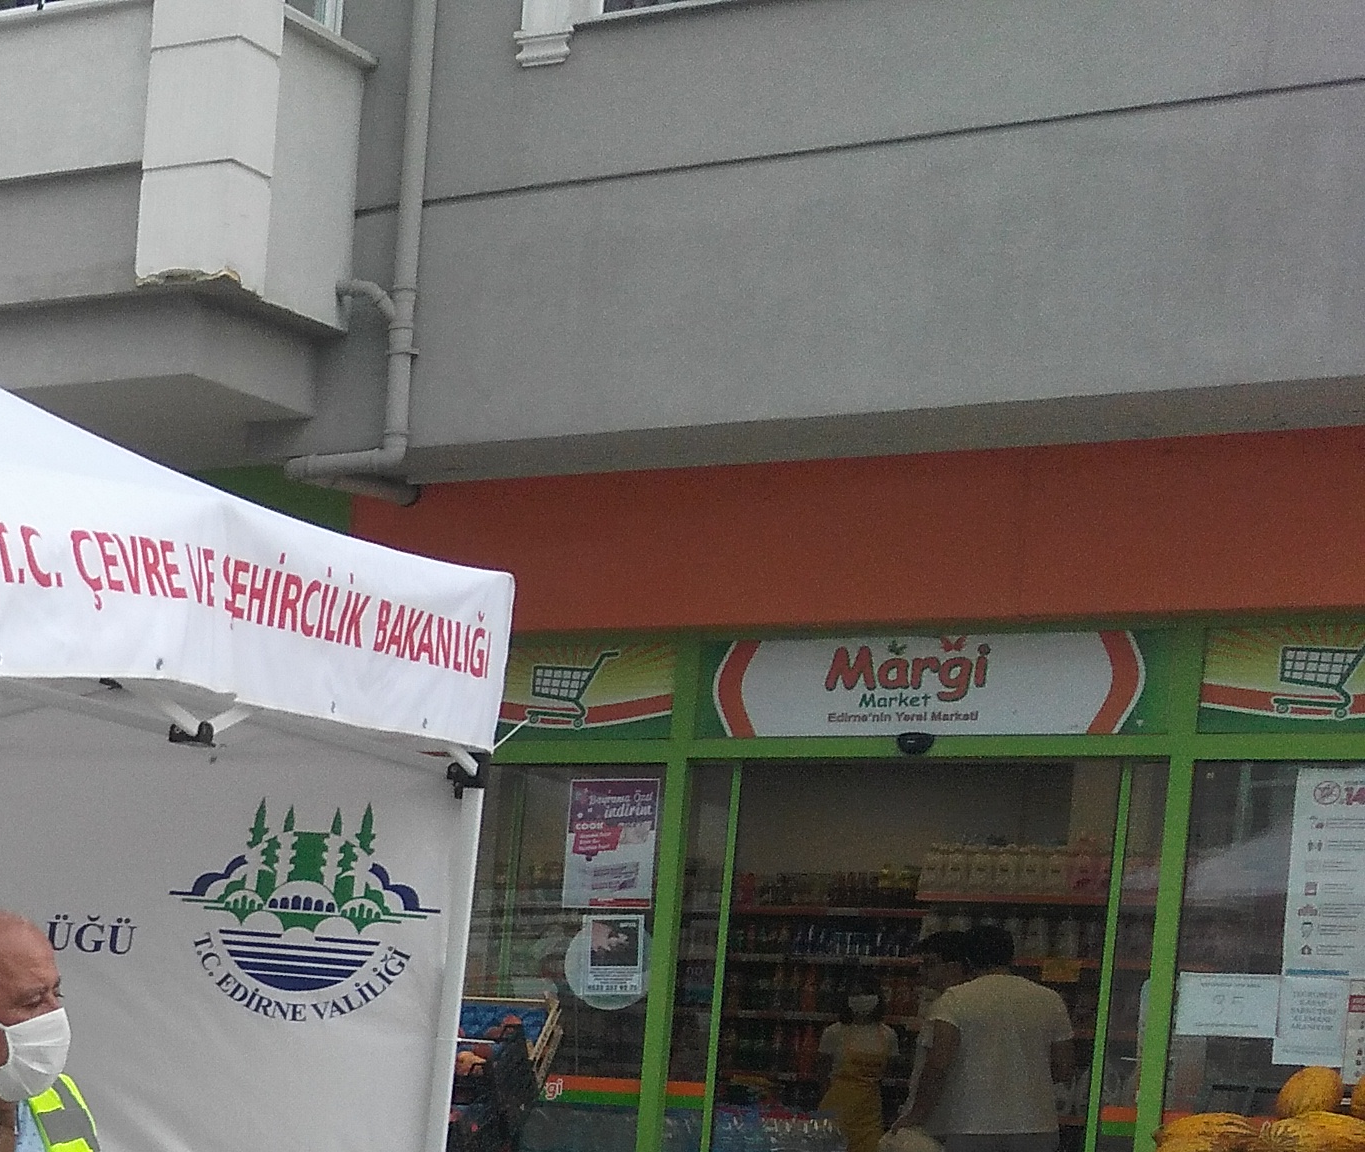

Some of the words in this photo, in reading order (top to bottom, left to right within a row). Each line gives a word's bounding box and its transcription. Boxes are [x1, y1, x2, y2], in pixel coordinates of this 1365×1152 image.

[69, 529, 189, 611] ÇEVRE
[185, 543, 215, 607] VE
[221, 552, 372, 649] ŞEHİRCİLİK
[372, 599, 492, 679] BAKANLIĞI
[858, 692, 931, 709] Market
[193, 932, 222, 977] T.C.
[215, 972, 307, 1023] EDİRNE
[311, 945, 412, 1021] VALİLİĞİ
